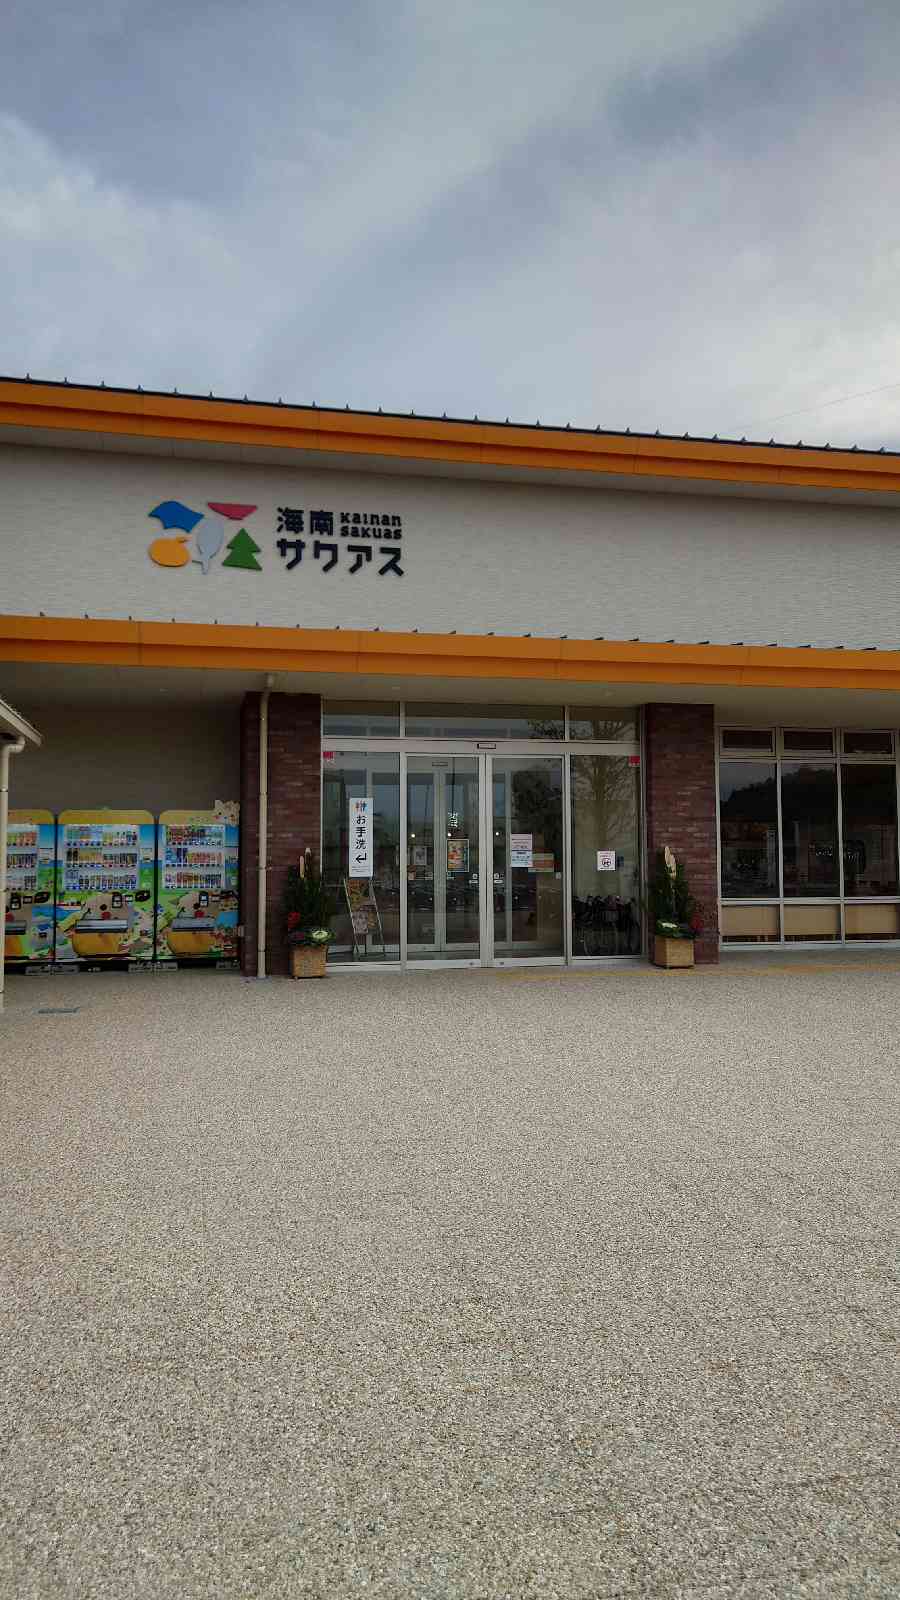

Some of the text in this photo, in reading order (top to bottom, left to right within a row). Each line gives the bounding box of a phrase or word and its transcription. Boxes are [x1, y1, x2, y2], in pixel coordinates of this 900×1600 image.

[276, 507, 334, 536] 海南
[276, 538, 404, 576] サクアス
[355, 815, 367, 850] お手洗
